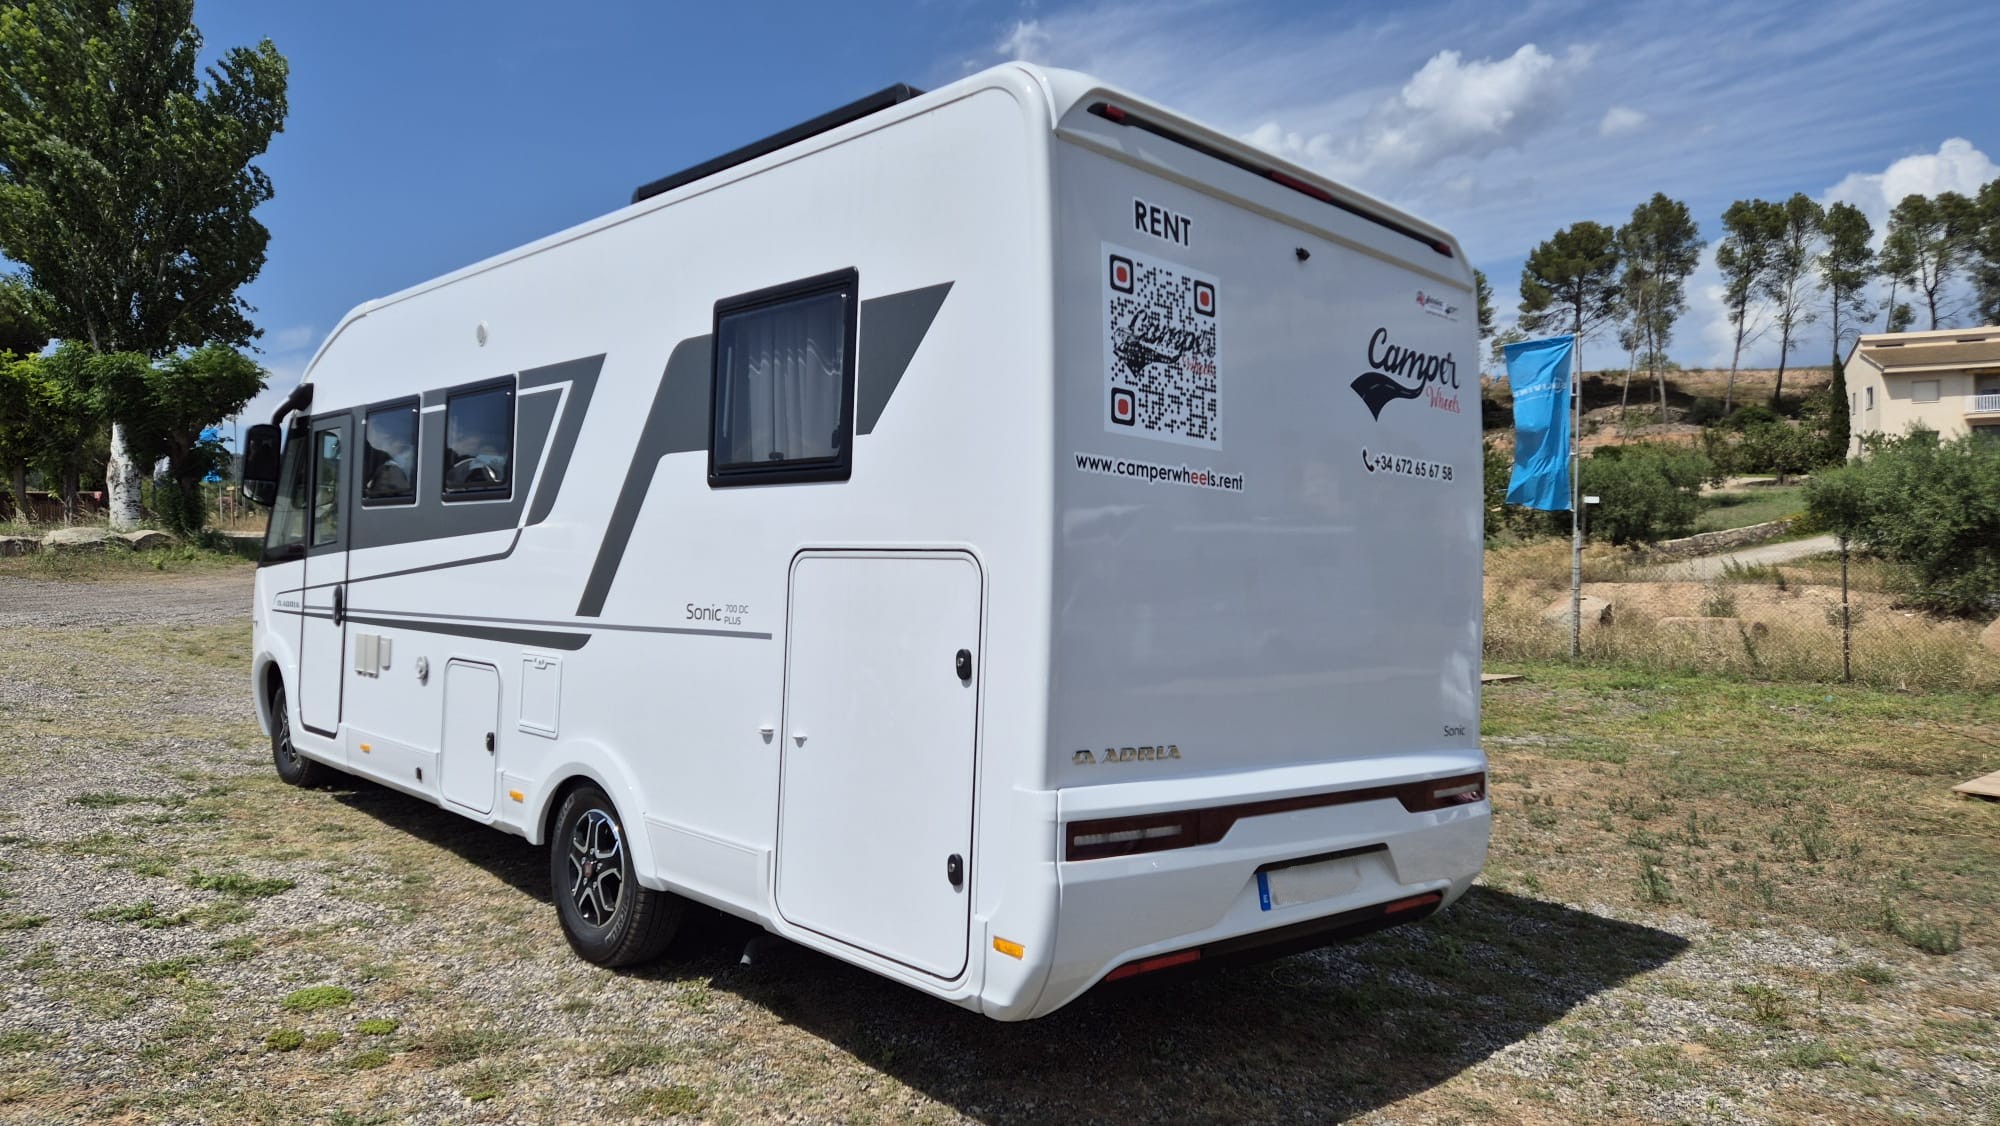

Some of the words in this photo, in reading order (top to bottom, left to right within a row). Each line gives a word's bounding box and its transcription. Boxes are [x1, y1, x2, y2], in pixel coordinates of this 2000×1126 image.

[1135, 200, 1191, 246] RENT
[1368, 328, 1459, 389] Camper
[1426, 386, 1460, 414] Wheels
[1076, 455, 1243, 491] www.camperwheels.rent
[1375, 455, 1393, 471] +34
[1395, 458, 1412, 475] 672
[1415, 461, 1426, 477] 65
[1429, 463, 1439, 478] 67
[1442, 466, 1453, 480] 58
[686, 603, 722, 621] Sonic
[725, 604, 738, 613] 700
[738, 605, 749, 614] DC
[724, 615, 741, 625] PLUS
[1443, 724, 1465, 736] Sonic
[1102, 745, 1181, 763] ADRIA
